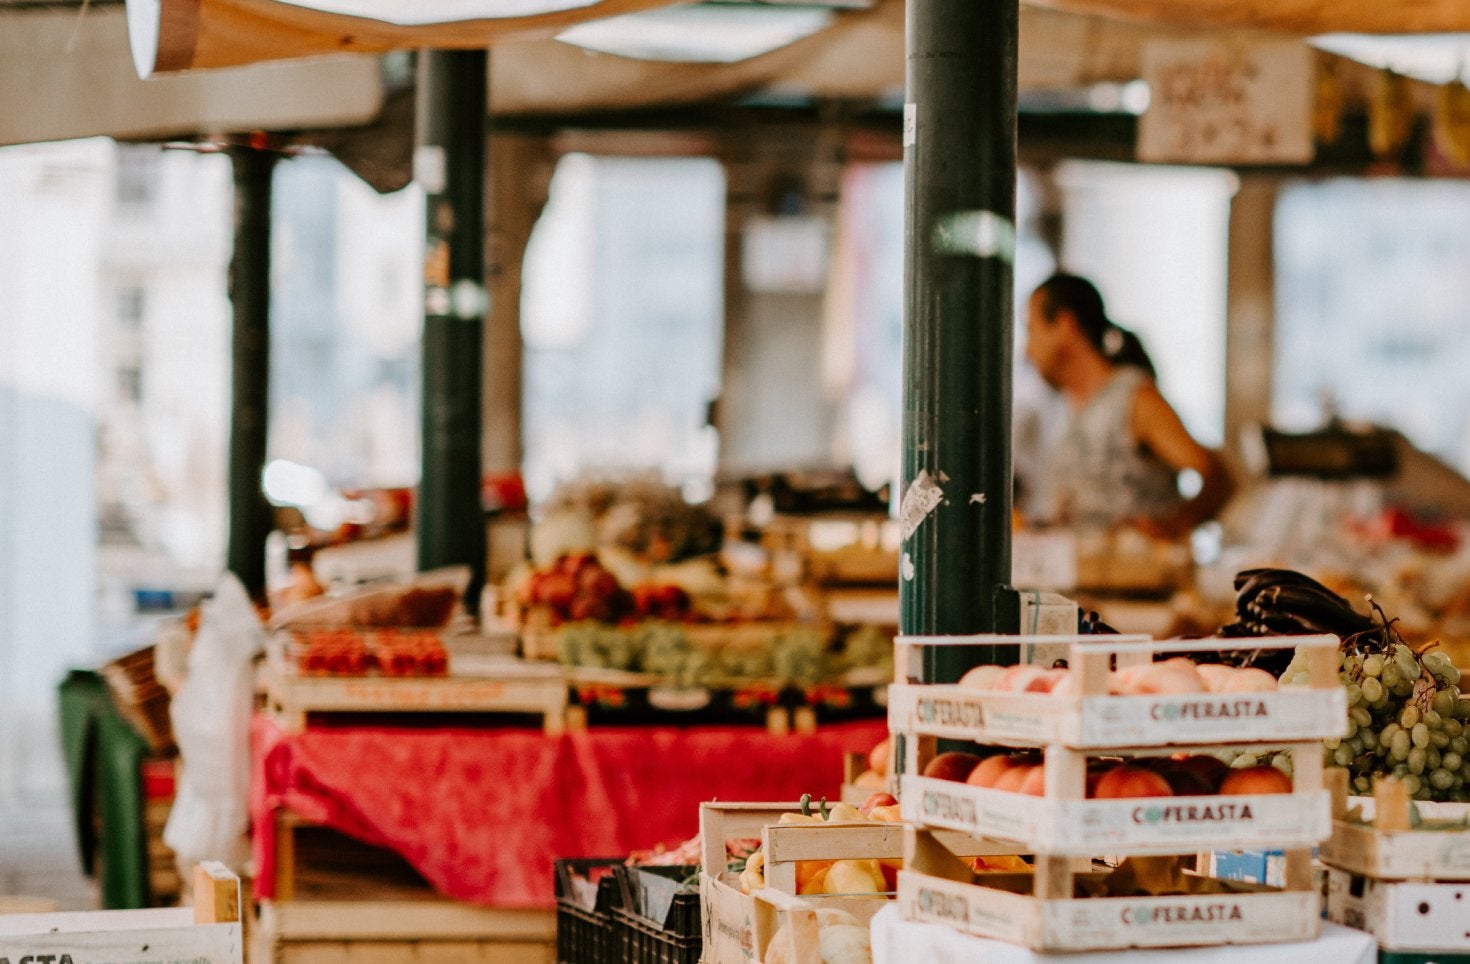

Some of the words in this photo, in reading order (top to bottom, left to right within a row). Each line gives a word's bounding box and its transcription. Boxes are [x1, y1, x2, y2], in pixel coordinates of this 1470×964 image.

[1151, 701, 1269, 721] COFERASTA
[1132, 803, 1254, 823] COFERASTA
[1120, 904, 1244, 925] COFERASTA
